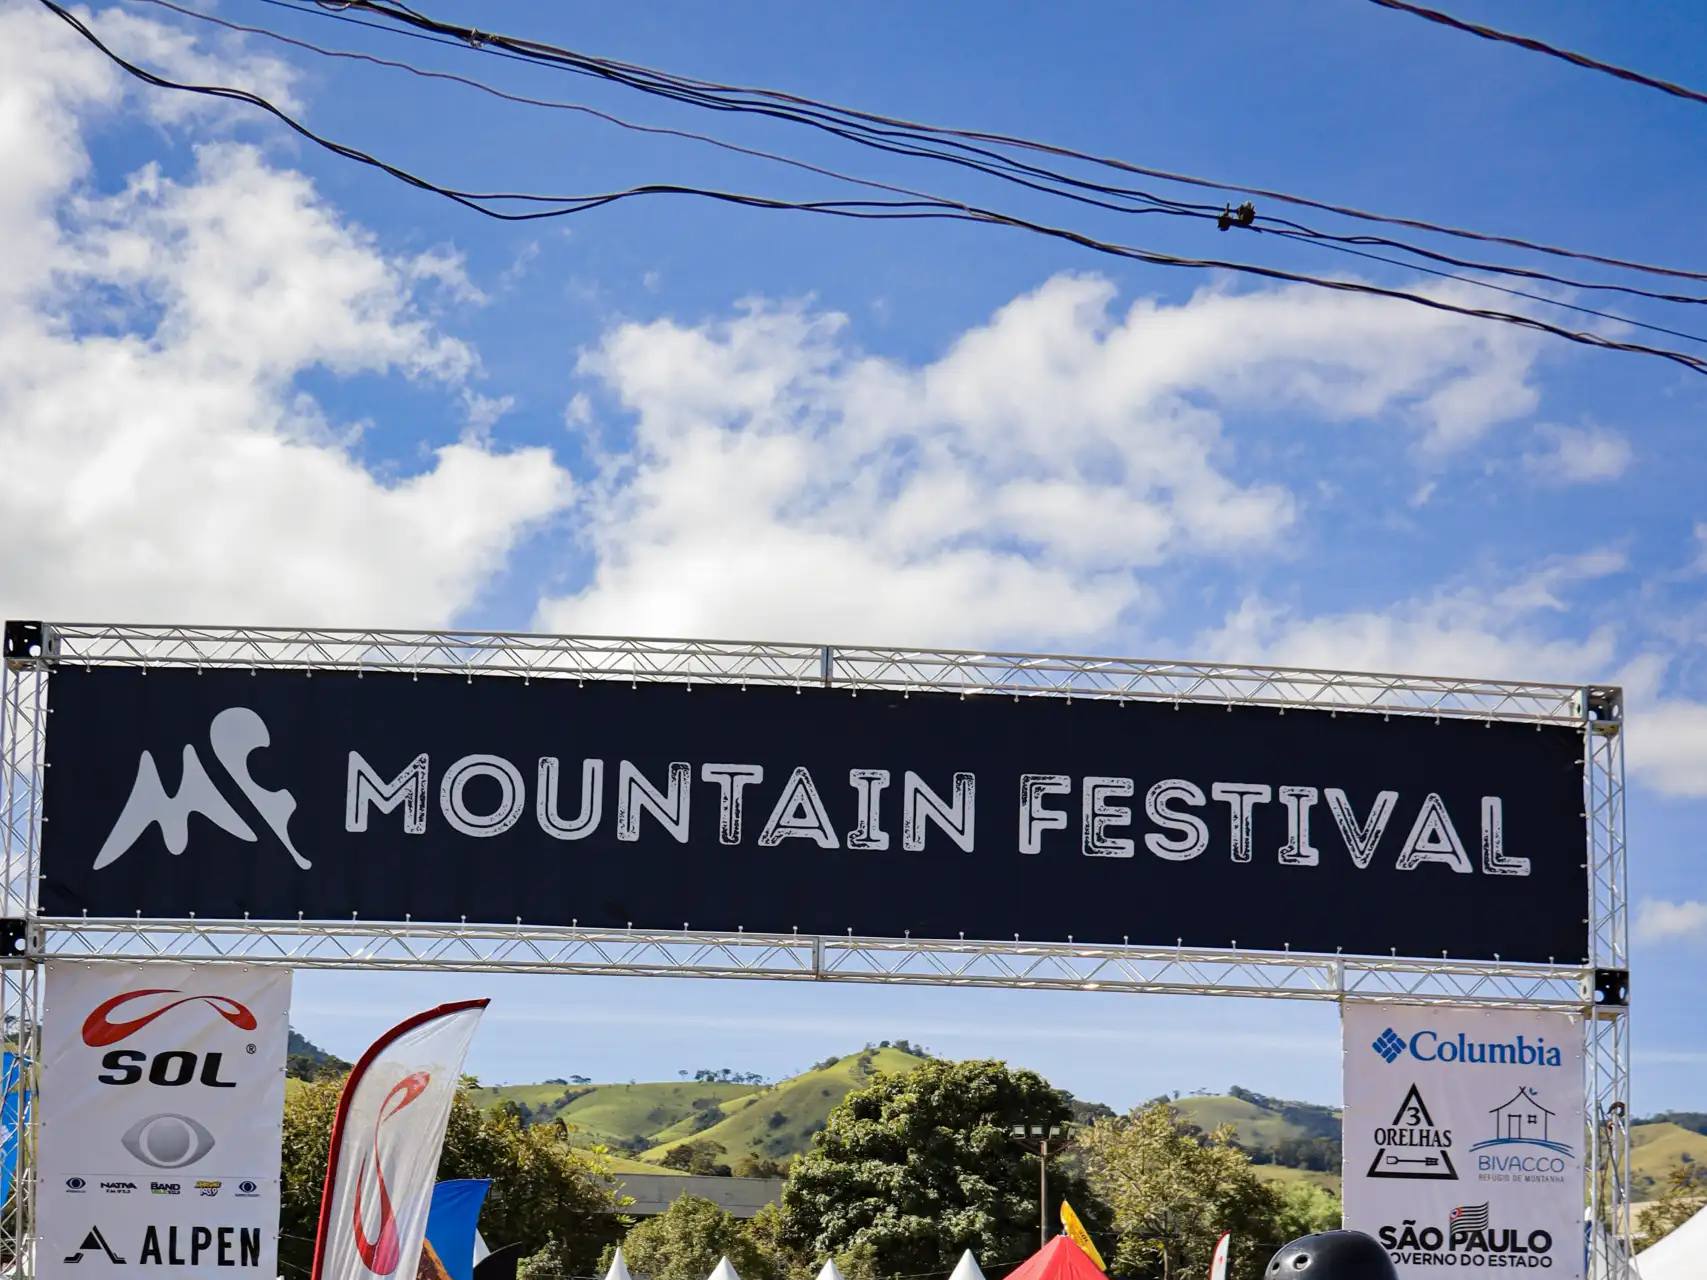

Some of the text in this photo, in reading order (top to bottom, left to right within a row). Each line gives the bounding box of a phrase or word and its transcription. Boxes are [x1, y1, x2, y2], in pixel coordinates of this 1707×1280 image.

[345, 750, 1531, 876] MOUNTAIN FESTIVAL
[1409, 1031, 1562, 1067] Columbia
[98, 1050, 237, 1088] SOL
[1406, 1106, 1421, 1127] 3
[1374, 1127, 1453, 1148] ORELHAS
[1478, 1155, 1565, 1173] BIVACCO
[100, 1181, 138, 1190] NATIVA
[139, 1225, 261, 1267] ALPEN
[1378, 1219, 1553, 1254] SÃO PAULO
[1391, 1252, 1553, 1269] OVERNO DO ESTADO
